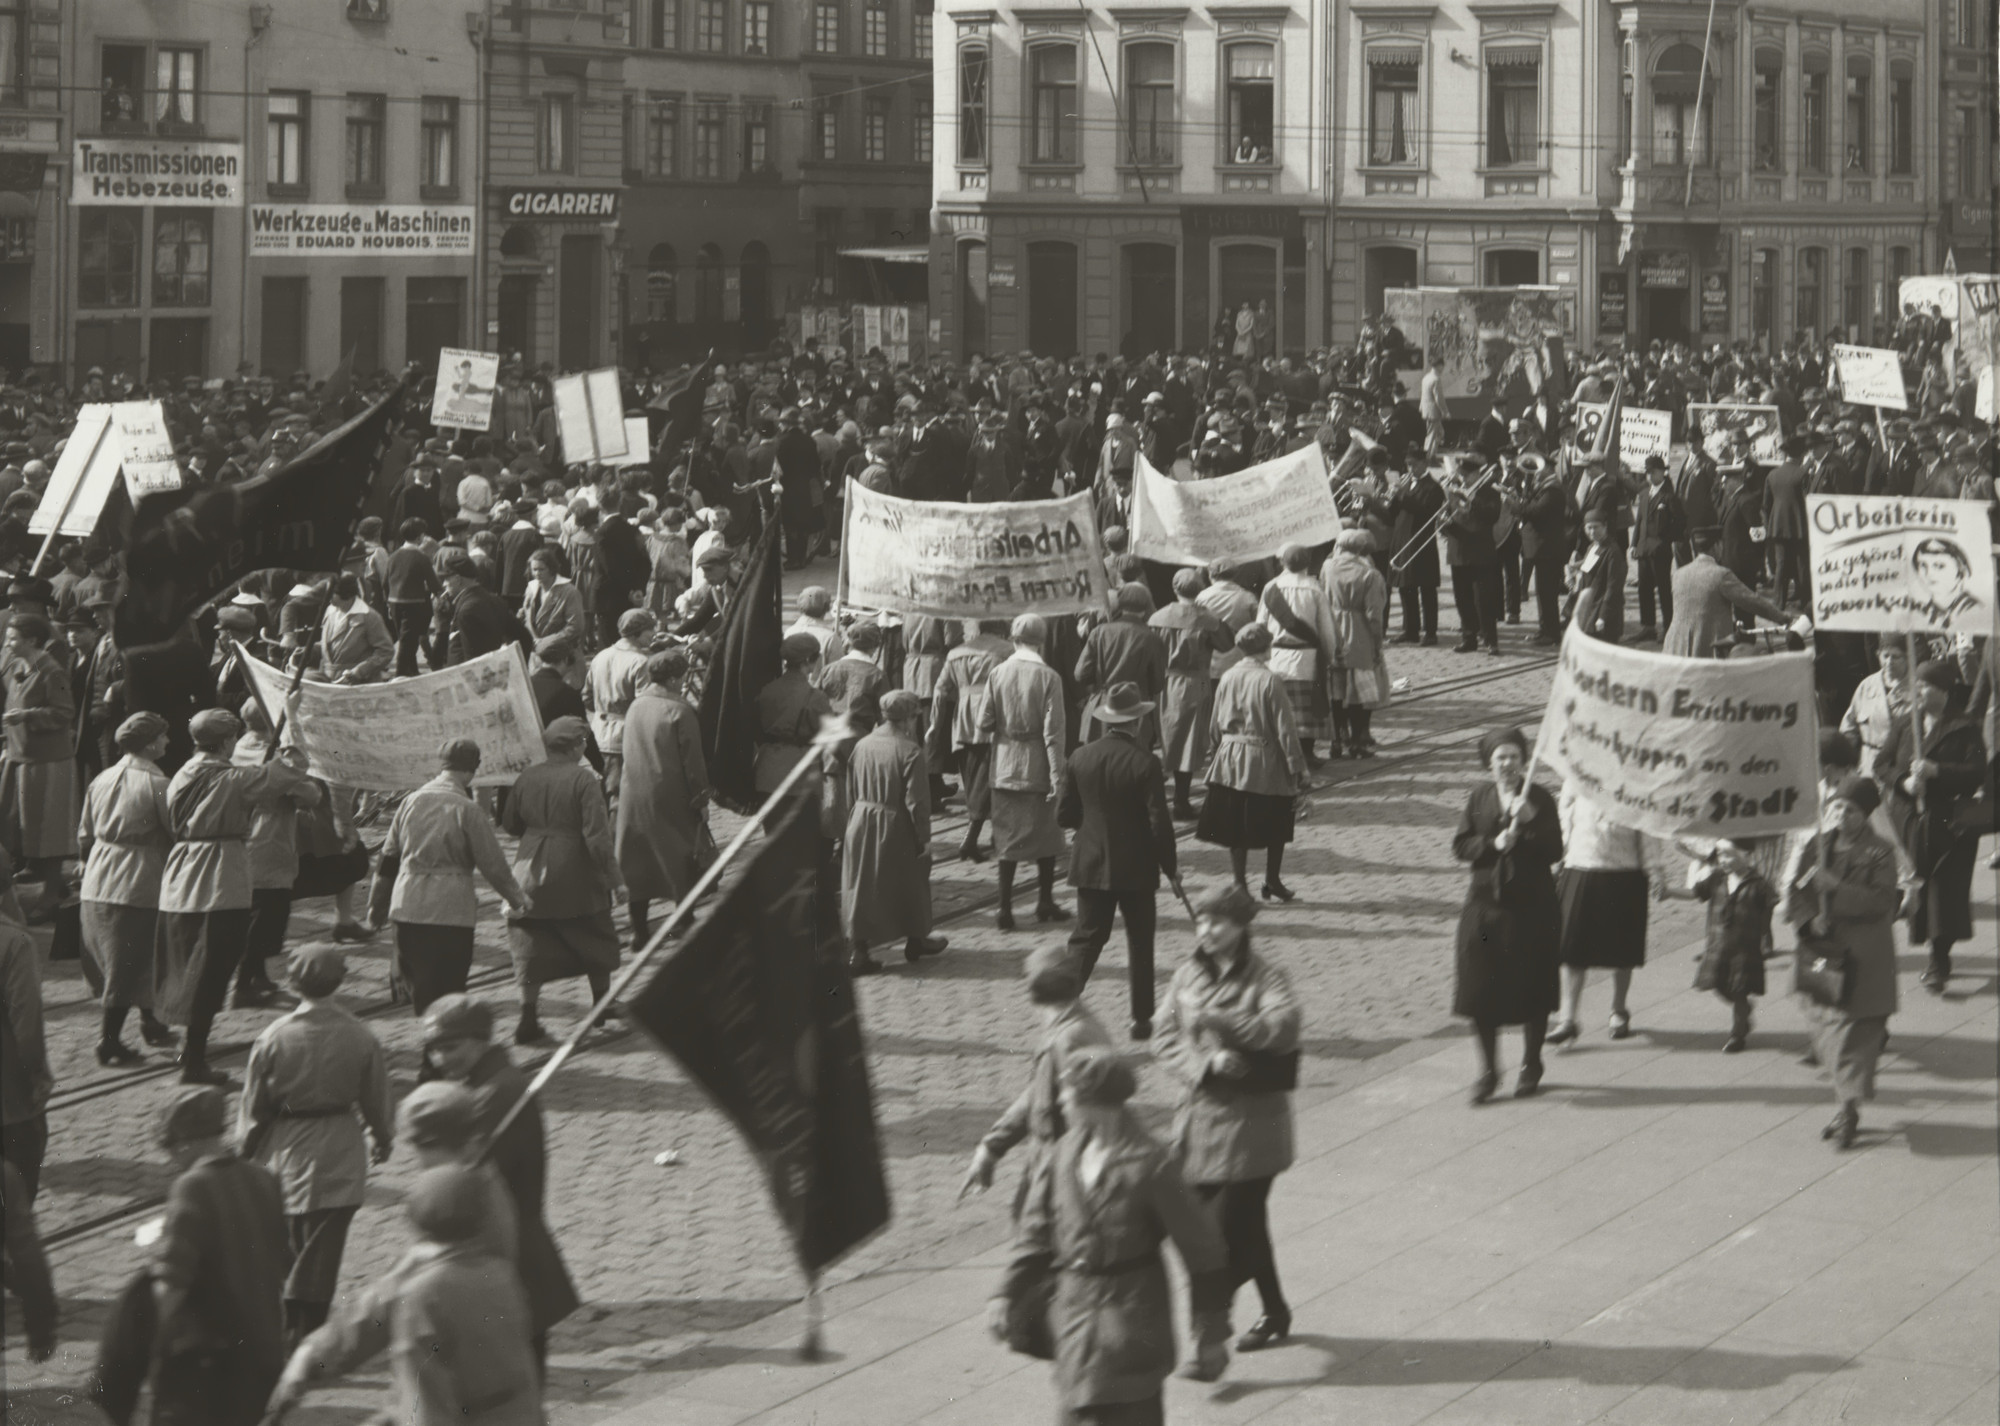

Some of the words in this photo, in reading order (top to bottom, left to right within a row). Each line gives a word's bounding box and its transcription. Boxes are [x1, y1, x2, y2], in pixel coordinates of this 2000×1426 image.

[80, 143, 238, 176] Transmissionen
[92, 176, 232, 200] Hebezeuge.
[509, 192, 615, 215] CIGARREN
[252, 208, 362, 234] Werkzeuge
[374, 209, 471, 233] Maschinen
[296, 236, 356, 249] EDUARD
[1814, 500, 1957, 534] Arbeiterin
[1701, 760, 1730, 775] an
[1740, 754, 1780, 776] den
[1709, 786, 1799, 824] Stadt
